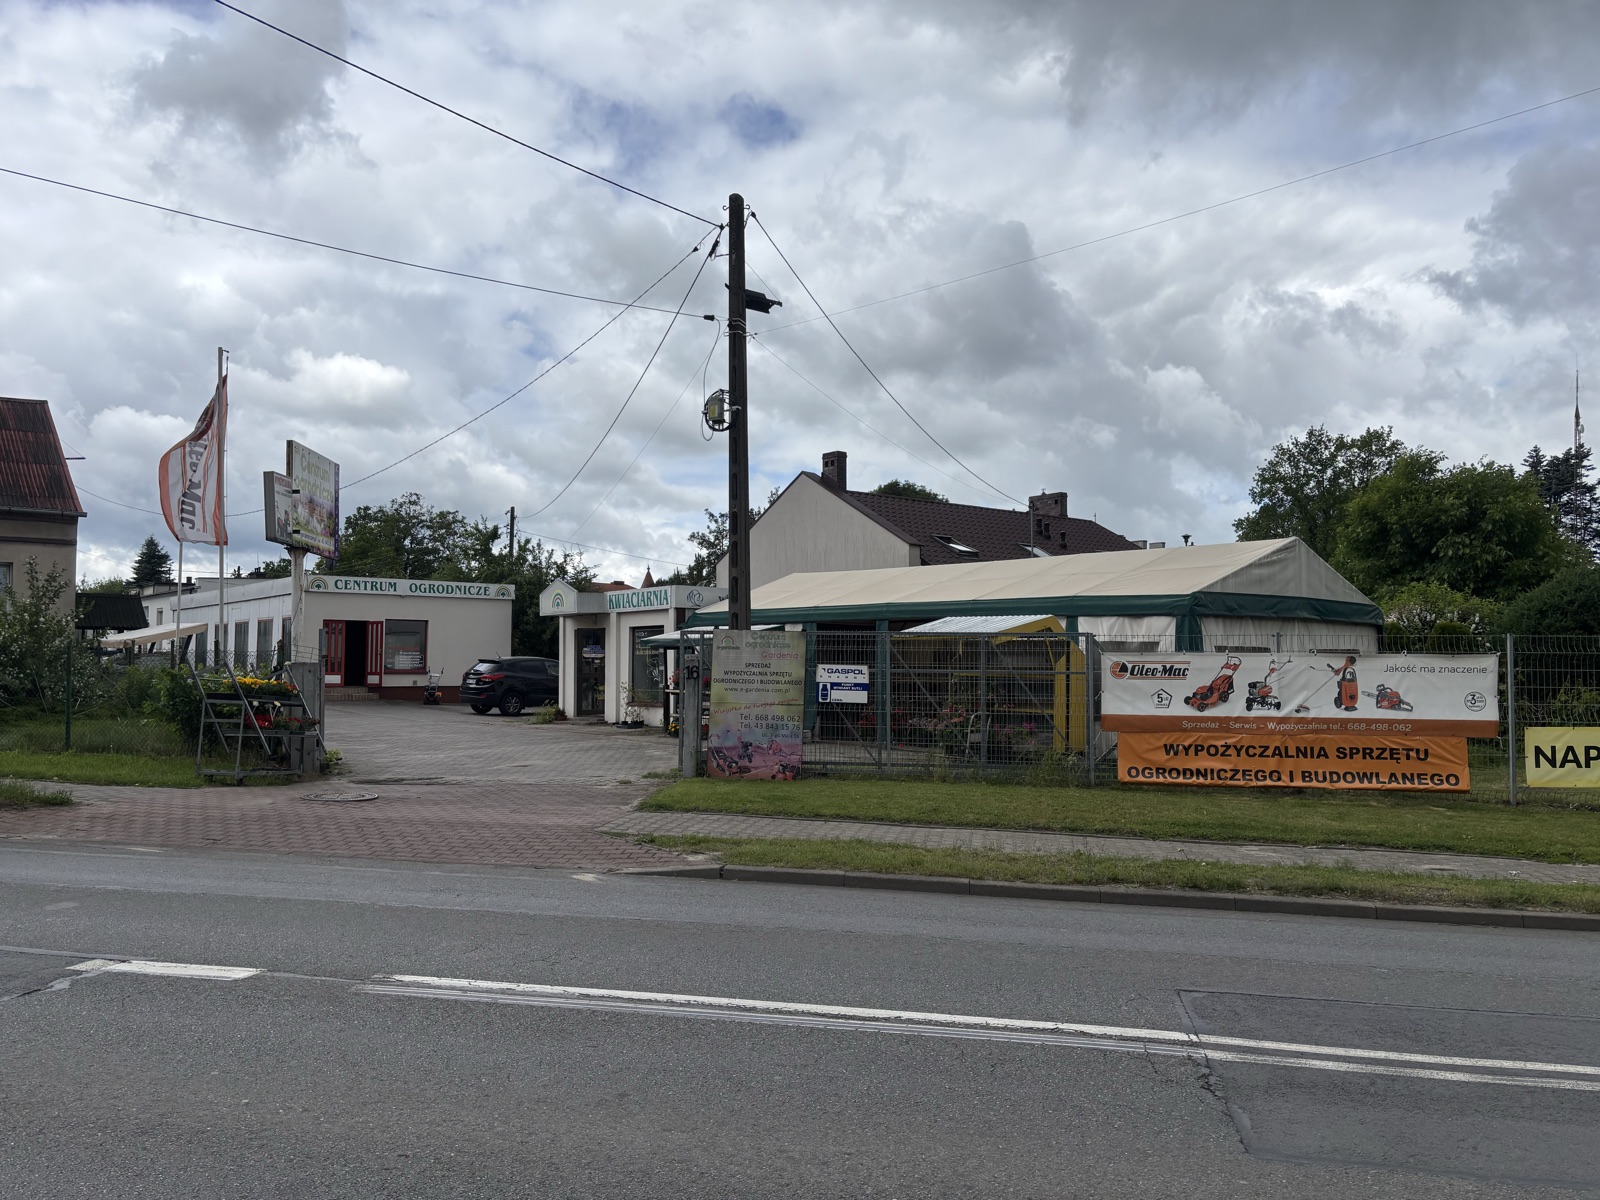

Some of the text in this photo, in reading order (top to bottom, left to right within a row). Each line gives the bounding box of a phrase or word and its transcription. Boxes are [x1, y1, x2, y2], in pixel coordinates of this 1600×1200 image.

[334, 579, 491, 597] CENTRUM OGRODNICZE
[608, 589, 669, 610] KWIACIARNIA
[761, 651, 799, 659] Gardenia
[684, 665, 699, 680] 16
[826, 667, 866, 675] GASPOL
[1384, 663, 1488, 674] Jakość ma znaczenie
[1157, 693, 1163, 703] 5
[1470, 694, 1477, 705] 3
[740, 713, 753, 721] Tel.
[740, 721, 753, 729] Tel.
[1182, 720, 1219, 729] Sprzedaż
[1229, 721, 1257, 729] Serwis
[1267, 722, 1327, 732] Wypożyczalnia
[1329, 723, 1345, 731] tel.:
[1347, 723, 1412, 732] 668-498-062
[1163, 742, 1429, 764] WYPOŻYCZALNIA SPRZĘTU
[1534, 745, 1600, 769] NAP
[1127, 766, 1460, 786] OGRODNICZEGO I BUDOWLANEGO
